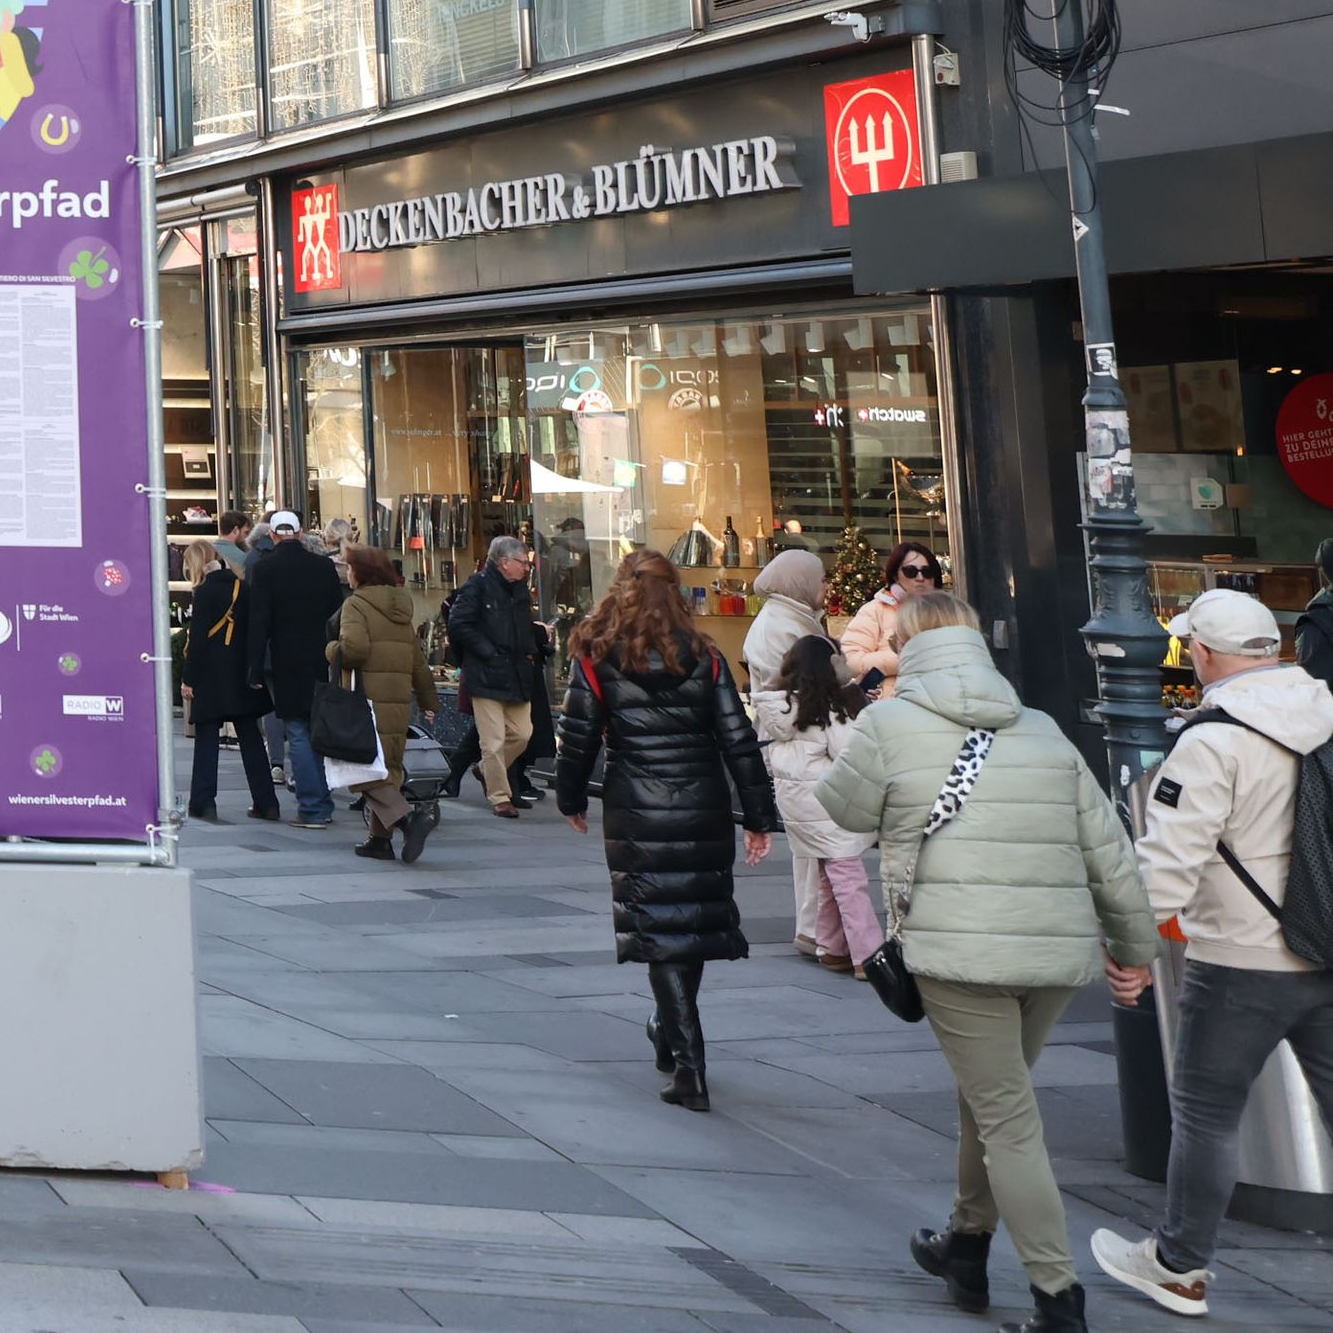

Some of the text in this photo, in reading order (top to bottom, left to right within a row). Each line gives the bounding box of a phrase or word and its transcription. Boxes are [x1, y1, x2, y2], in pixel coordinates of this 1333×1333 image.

[338, 135, 785, 253] DECKENBACHER & BLÜMNER
[1283, 432, 1305, 443] HIER
[1284, 444, 1299, 453] ZU
[39, 613, 79, 622] Stadt Wien
[67, 700, 121, 712] RADIO W
[8, 794, 127, 808] wienersilvesterpfad.at
